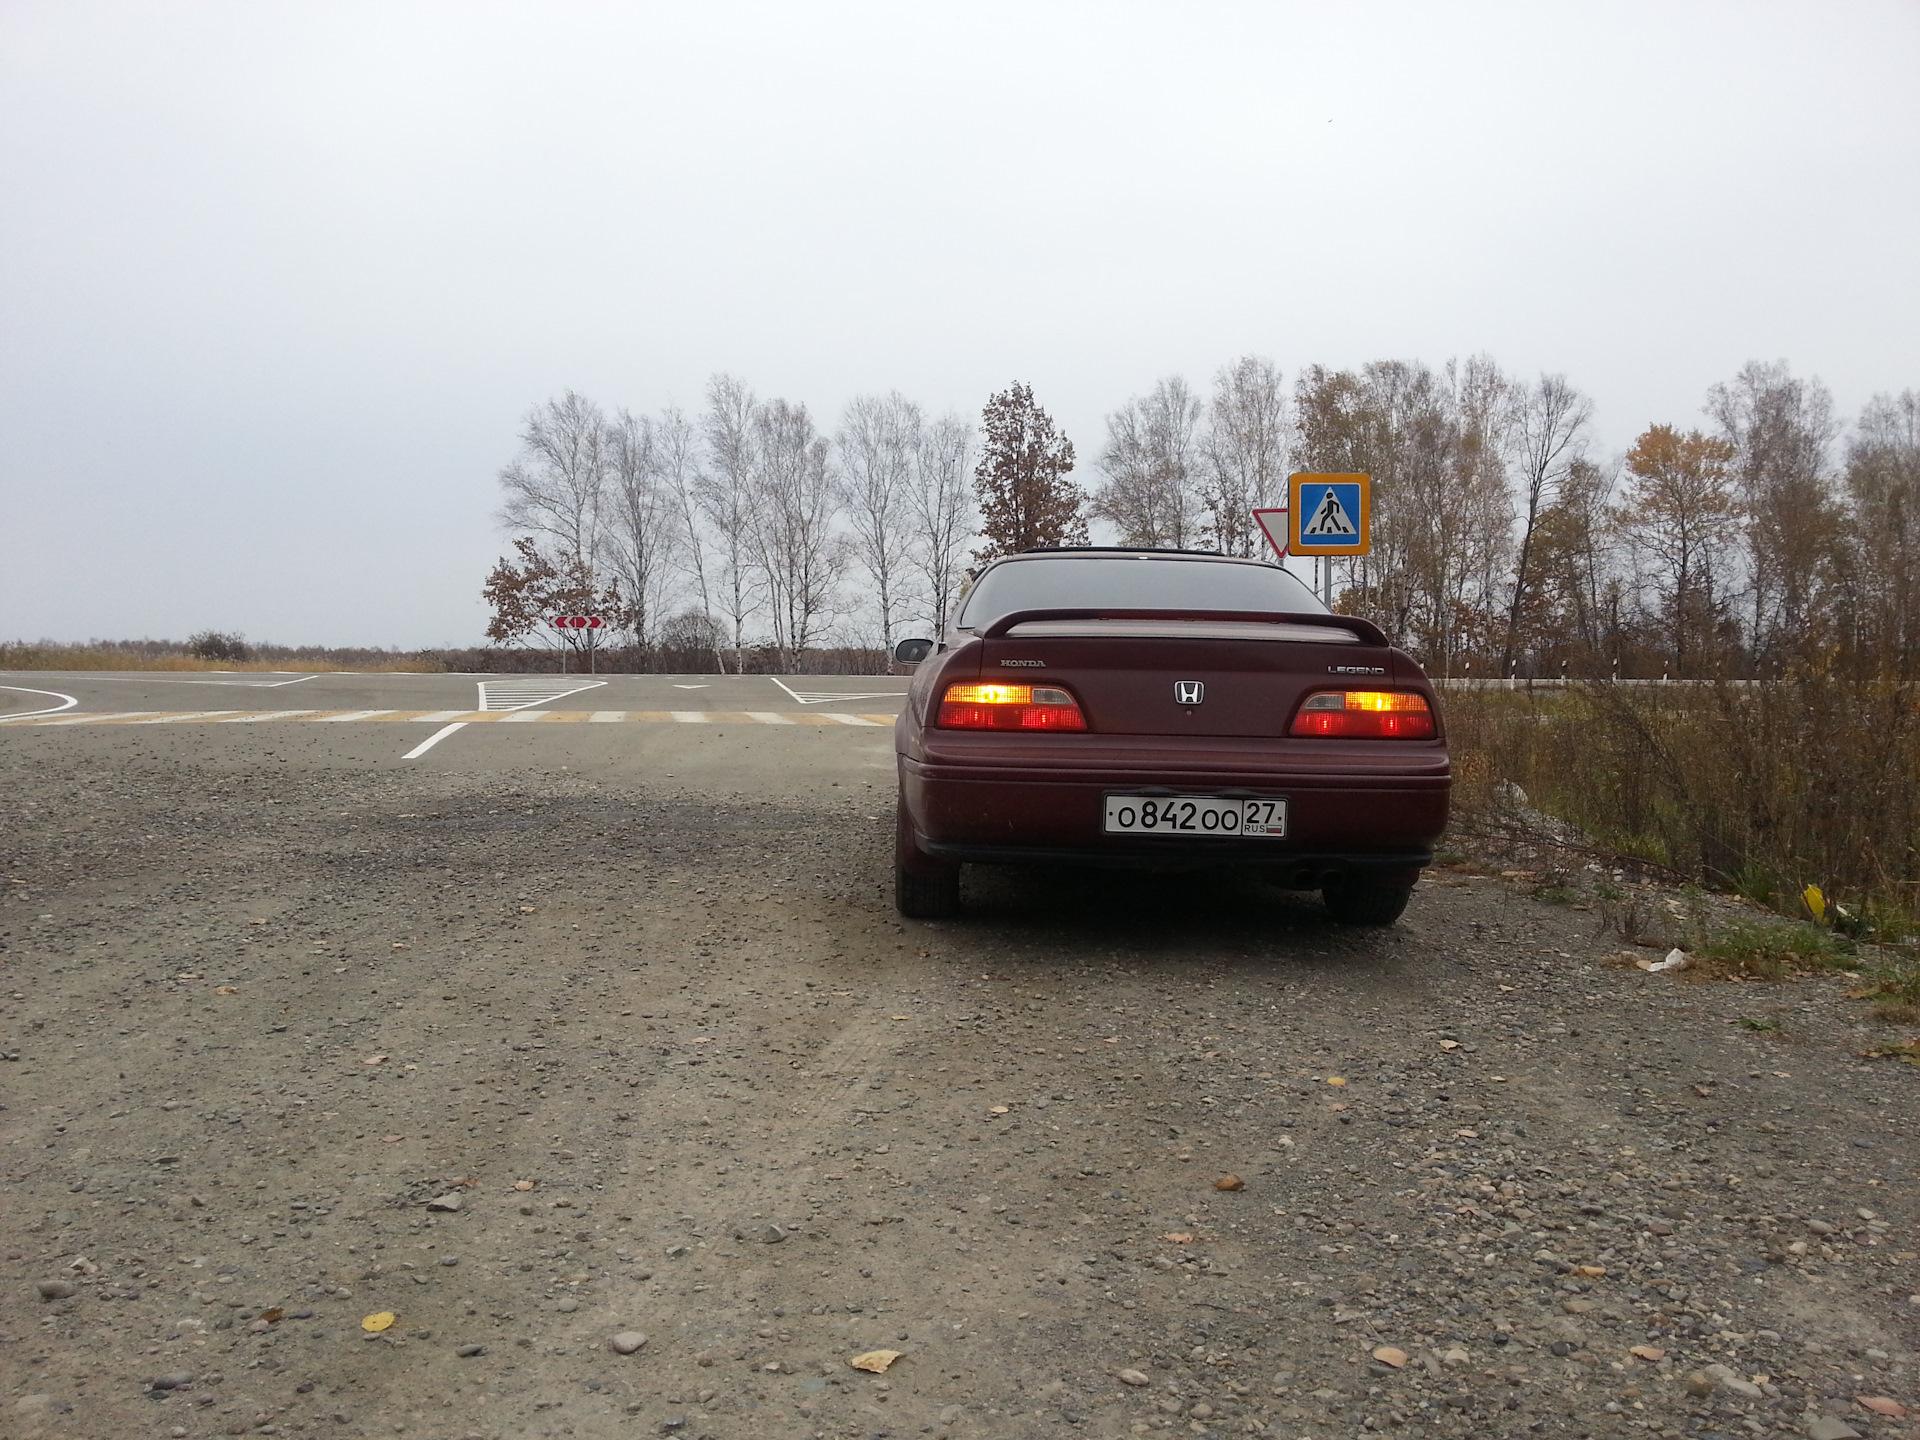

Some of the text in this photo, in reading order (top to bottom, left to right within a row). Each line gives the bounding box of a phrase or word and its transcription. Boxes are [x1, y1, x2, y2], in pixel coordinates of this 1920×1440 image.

[1000, 659, 1046, 667] HONDA
[1327, 665, 1385, 675] LEGEND
[1246, 802, 1276, 824] 27
[1244, 824, 1266, 833] RUS
